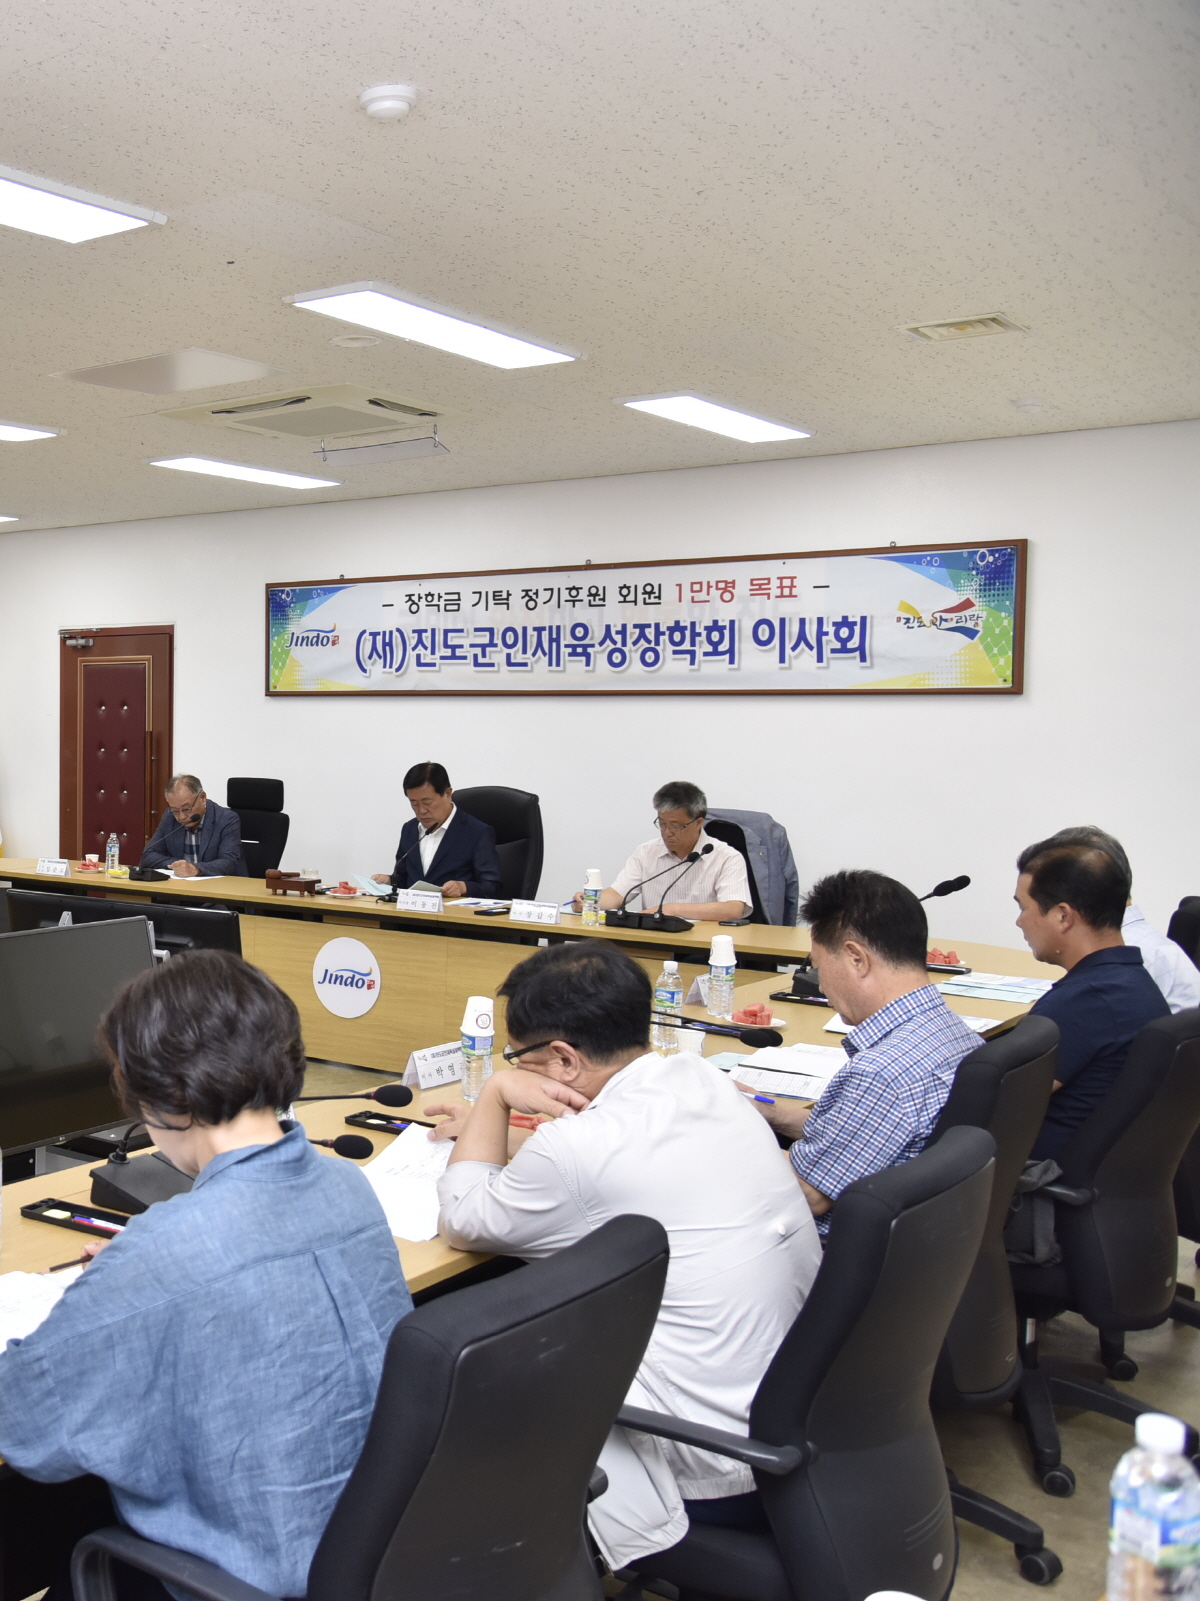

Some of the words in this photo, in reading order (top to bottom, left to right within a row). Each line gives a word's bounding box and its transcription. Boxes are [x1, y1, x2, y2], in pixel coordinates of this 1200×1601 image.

[405, 592, 461, 614] 장학금
[472, 590, 511, 611] 기탁
[521, 585, 606, 611] 정기후원
[618, 583, 662, 606] 회원
[675, 579, 736, 603] 1만명
[749, 576, 798, 600] 목표
[285, 632, 330, 648] Jindo
[355, 619, 736, 674] (재)진도군인재육성장학회
[751, 615, 868, 665] 이사회
[318, 969, 365, 989] Jindo
